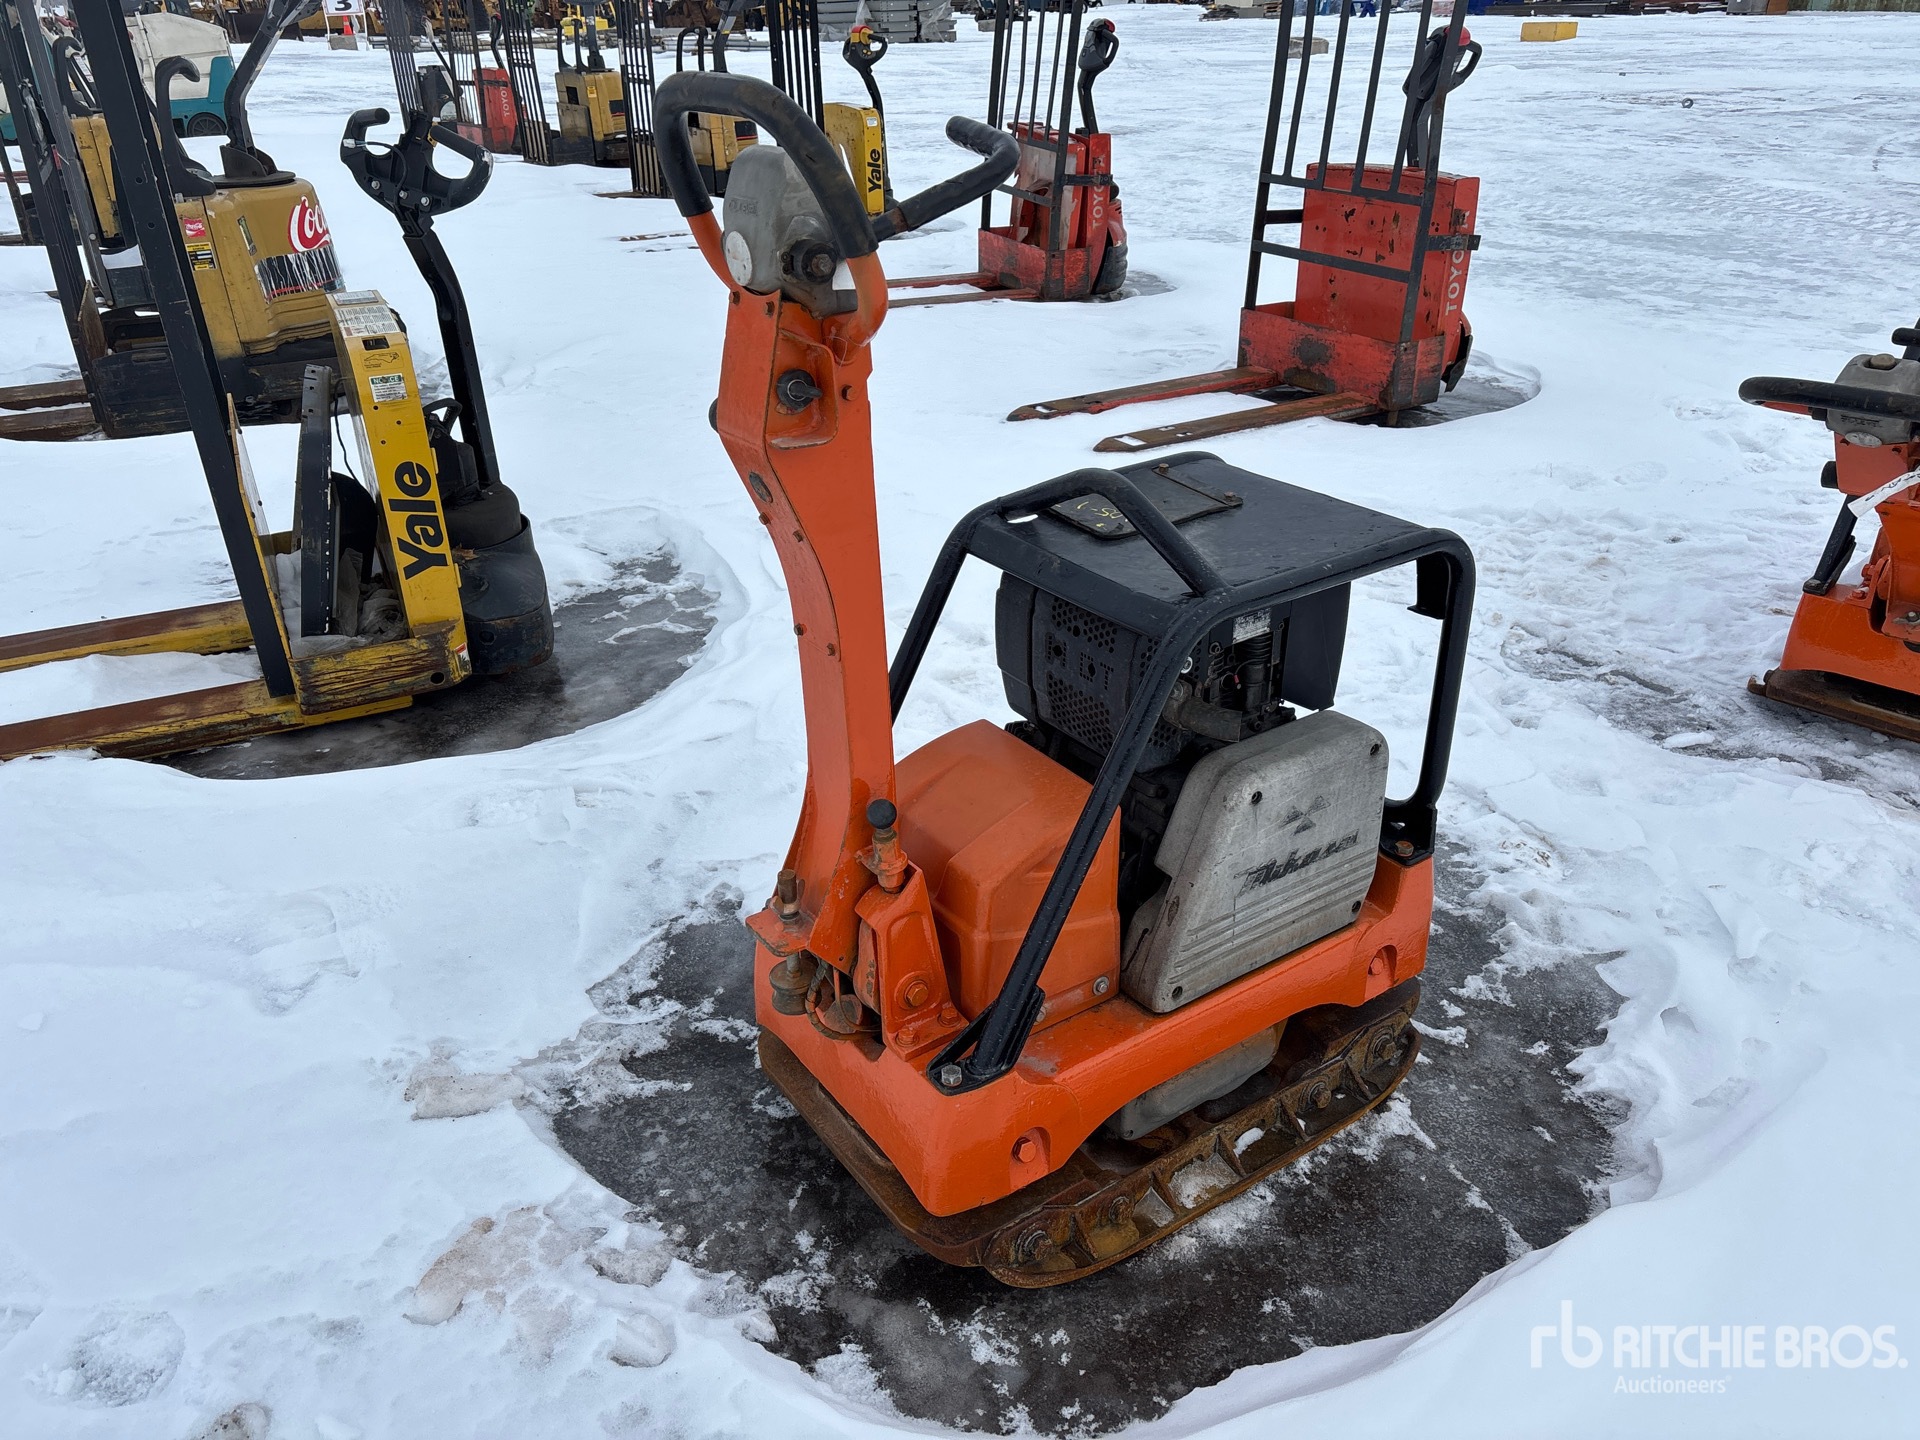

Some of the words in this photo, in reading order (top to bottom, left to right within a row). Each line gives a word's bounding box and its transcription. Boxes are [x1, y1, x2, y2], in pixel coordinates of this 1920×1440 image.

[867, 148, 882, 193] Yale
[1092, 154, 1106, 229] TOYO
[291, 196, 331, 253] Coc
[1445, 210, 1470, 316] TOYO
[387, 461, 449, 580] Yale
